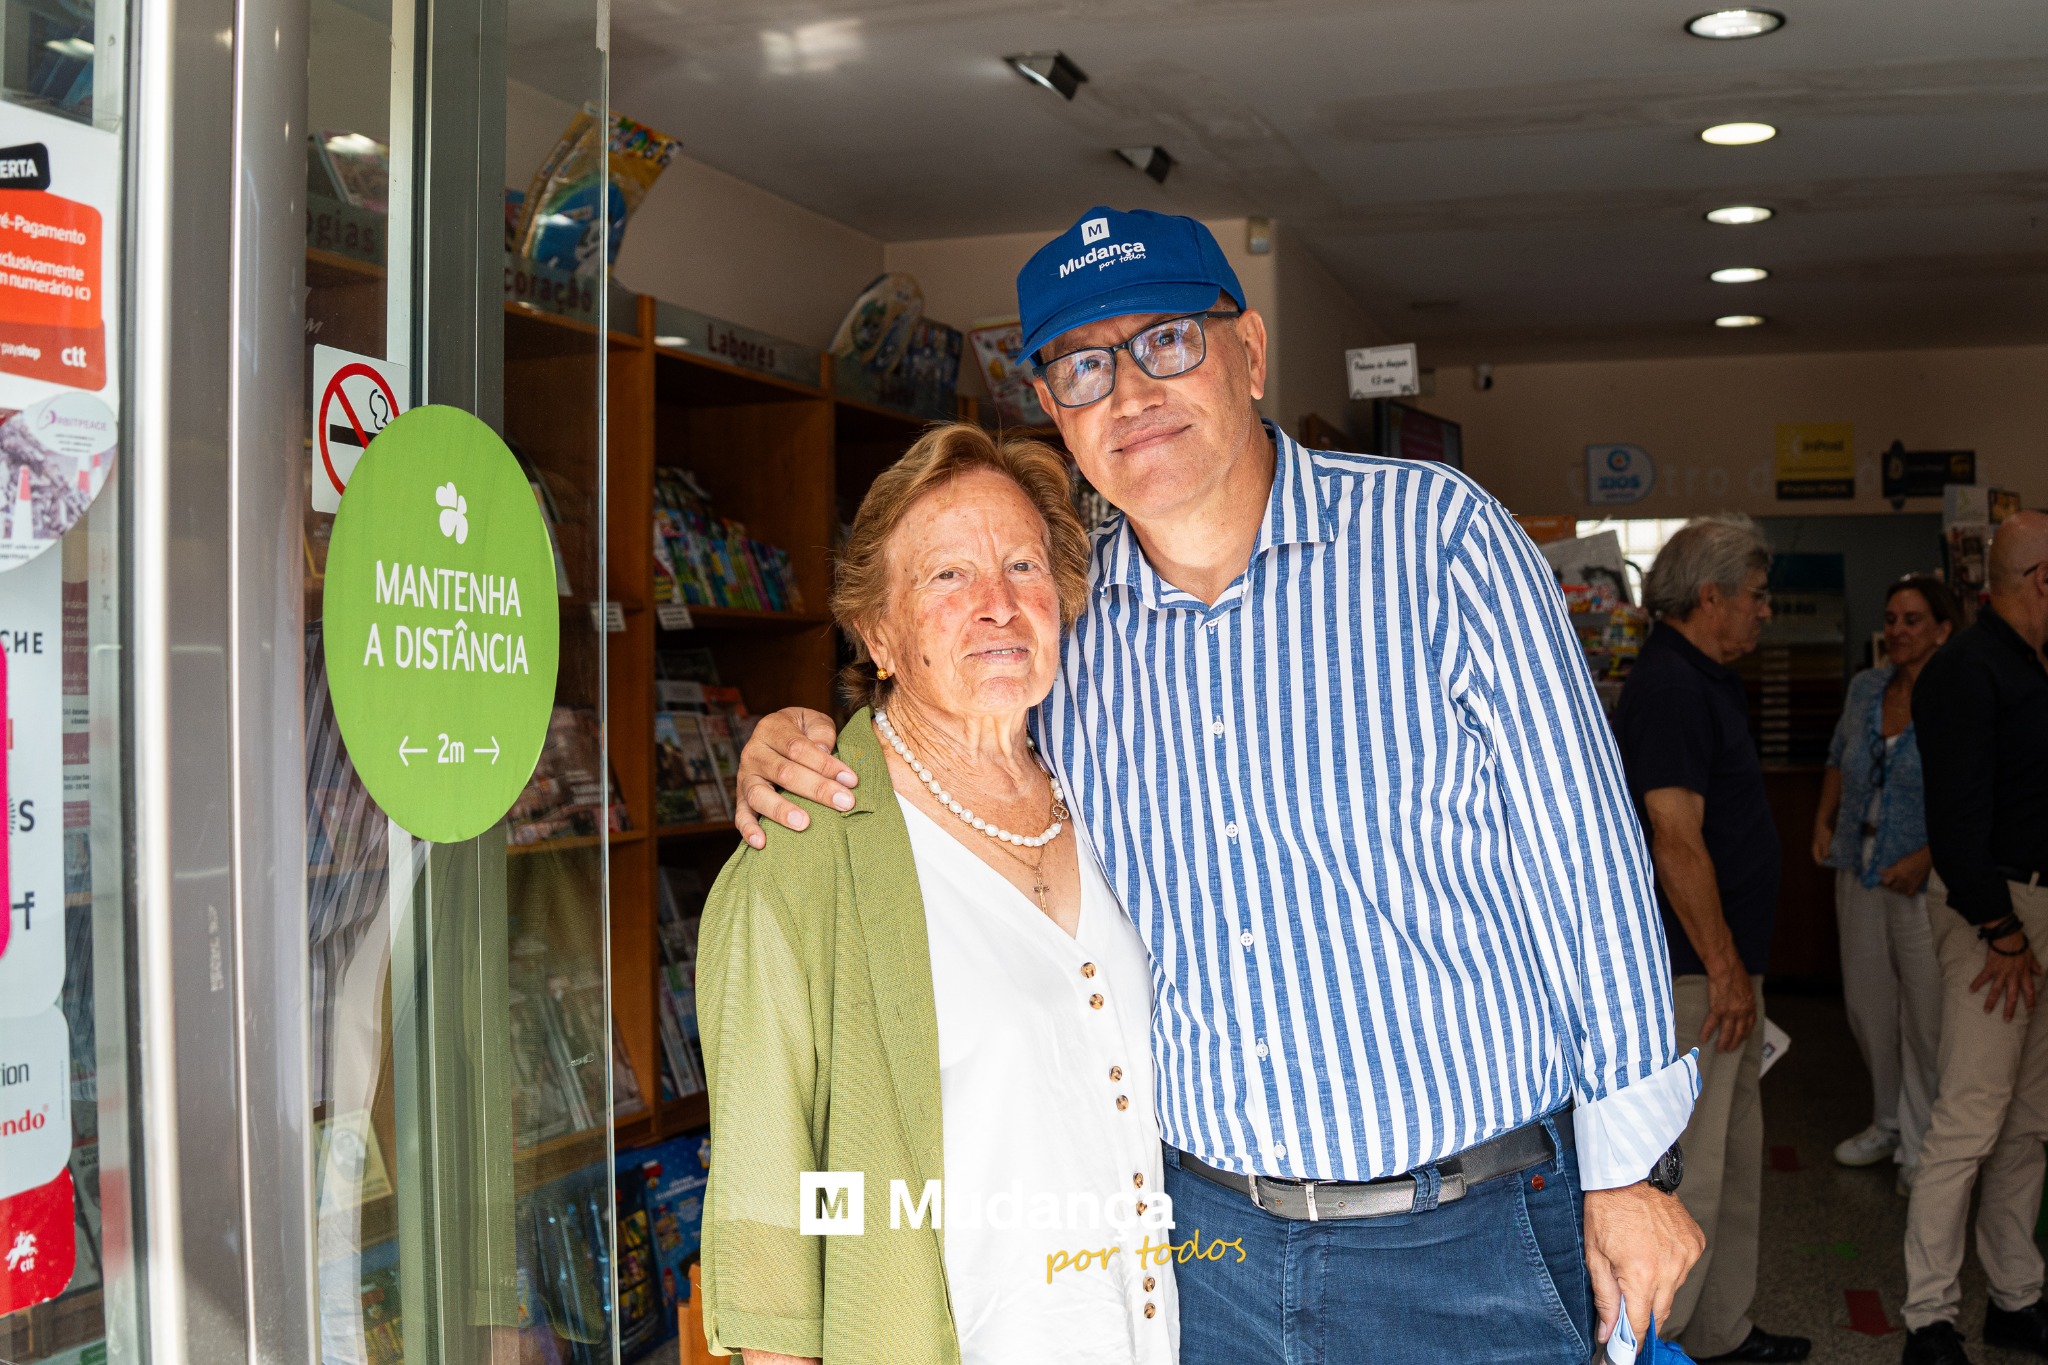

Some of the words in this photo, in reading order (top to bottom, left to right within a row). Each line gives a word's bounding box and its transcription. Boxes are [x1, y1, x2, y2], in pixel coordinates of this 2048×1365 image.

[1088, 224, 1102, 237] M
[1060, 242, 1146, 278] Mudança
[1099, 258, 1117, 271] por
[1119, 252, 1146, 264] todos
[9, 273, 73, 298] numerário
[61, 346, 88, 368] ctt
[708, 322, 775, 369] Labores
[376, 560, 522, 617] MANTENHA
[363, 622, 384, 667] A
[395, 618, 529, 675] DISTÂNCIA
[437, 733, 465, 763] 2m
[0, 1108, 45, 1136] ndo
